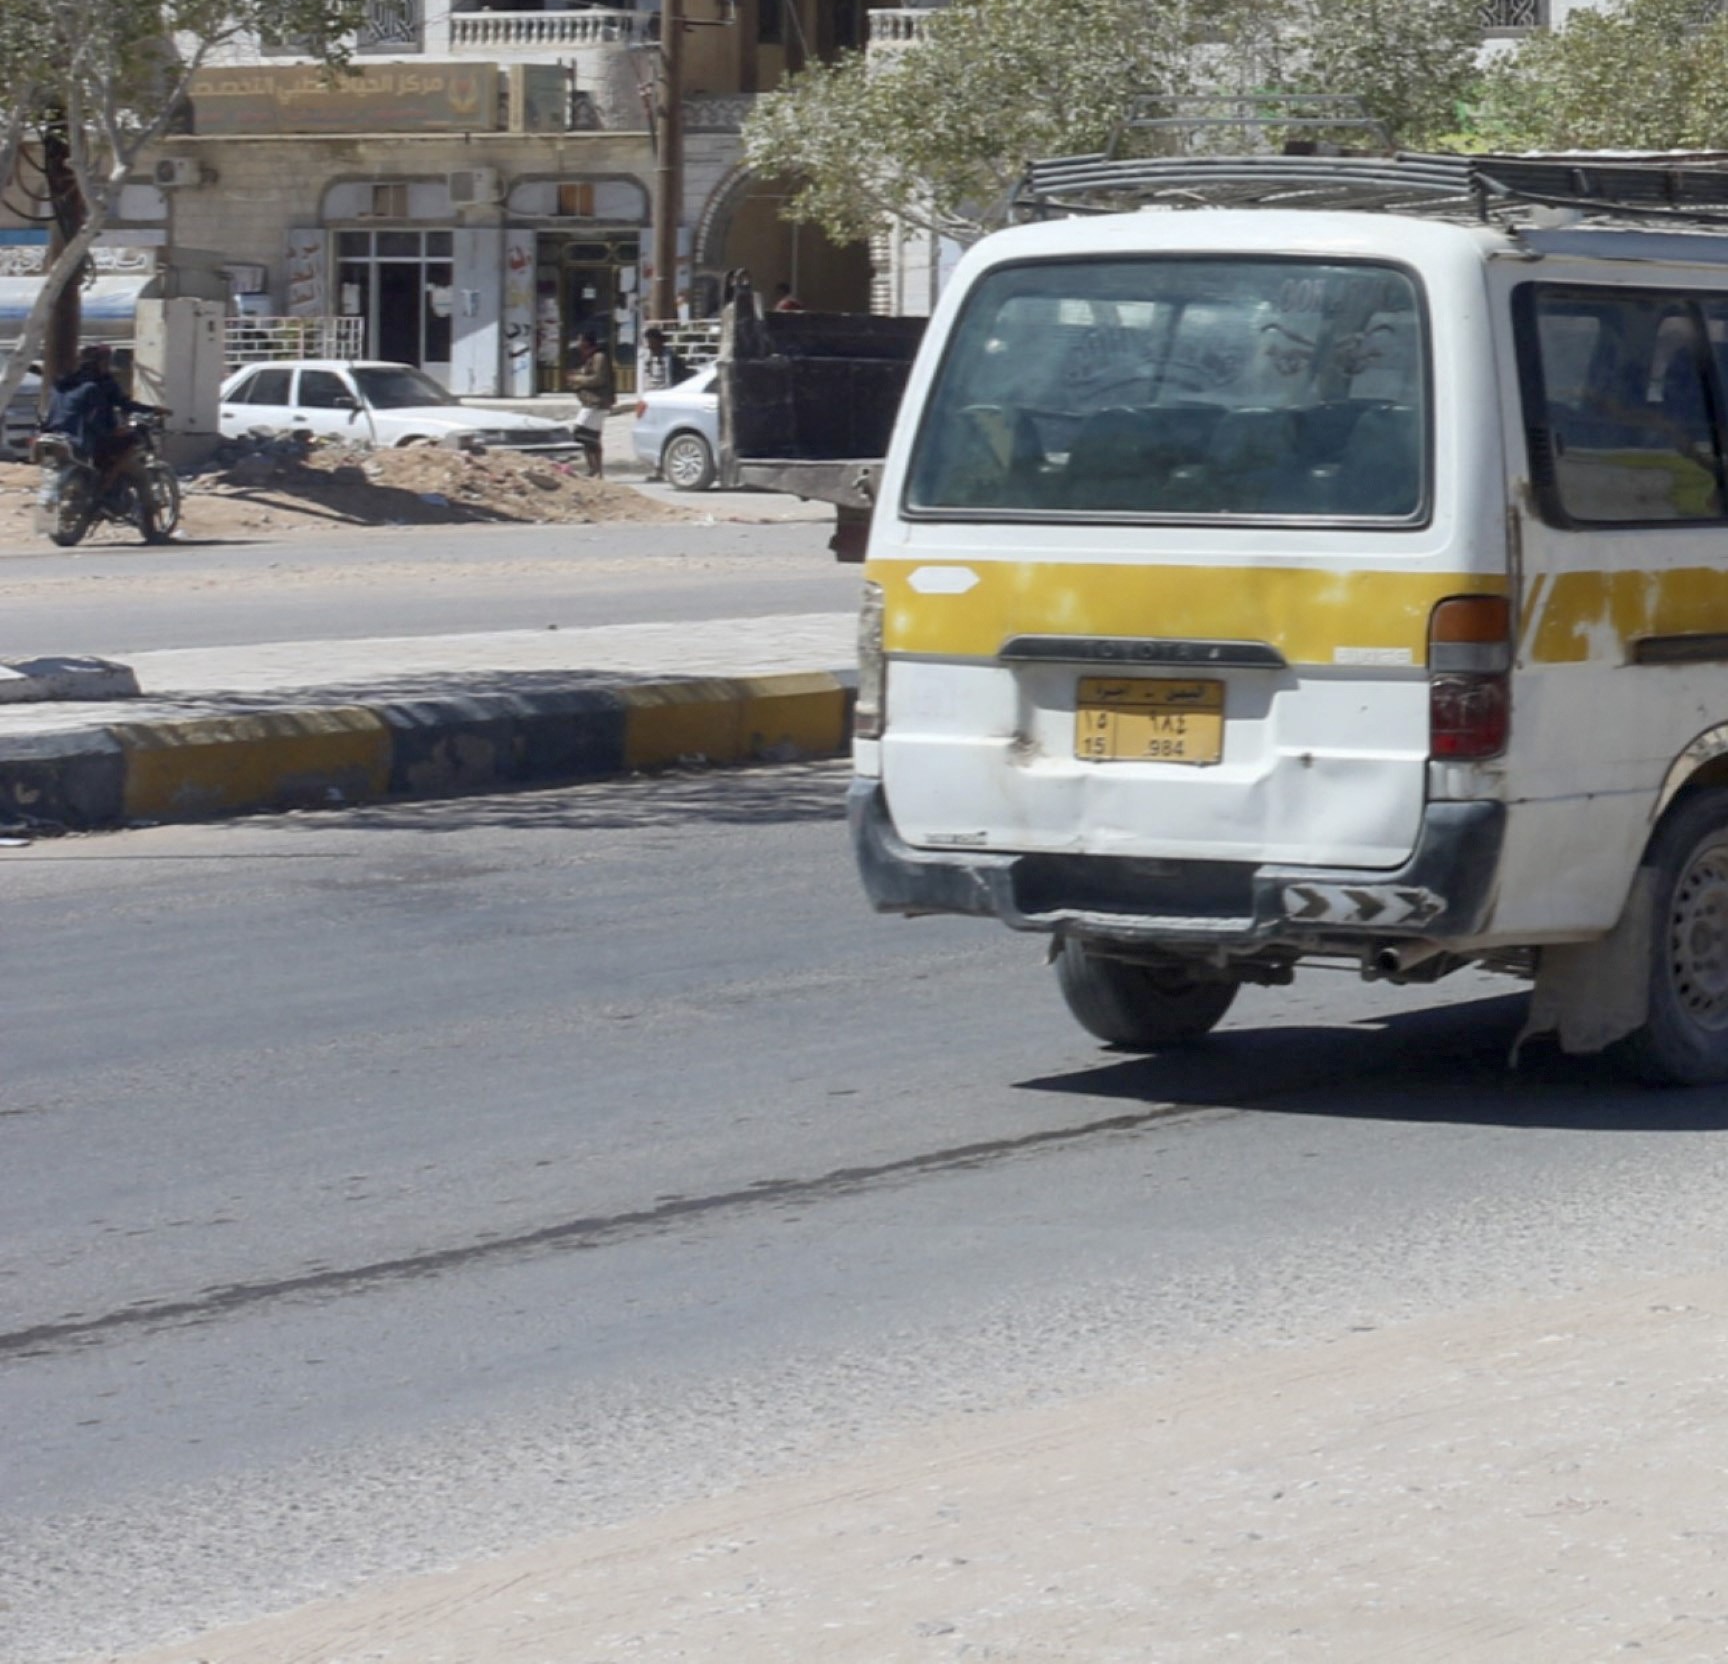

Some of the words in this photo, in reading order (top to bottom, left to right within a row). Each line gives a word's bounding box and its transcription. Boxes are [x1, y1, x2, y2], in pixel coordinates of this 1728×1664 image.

[393, 74, 444, 97] مركز
[1083, 737, 1107, 755] 15
[1149, 739, 1185, 757] 984
